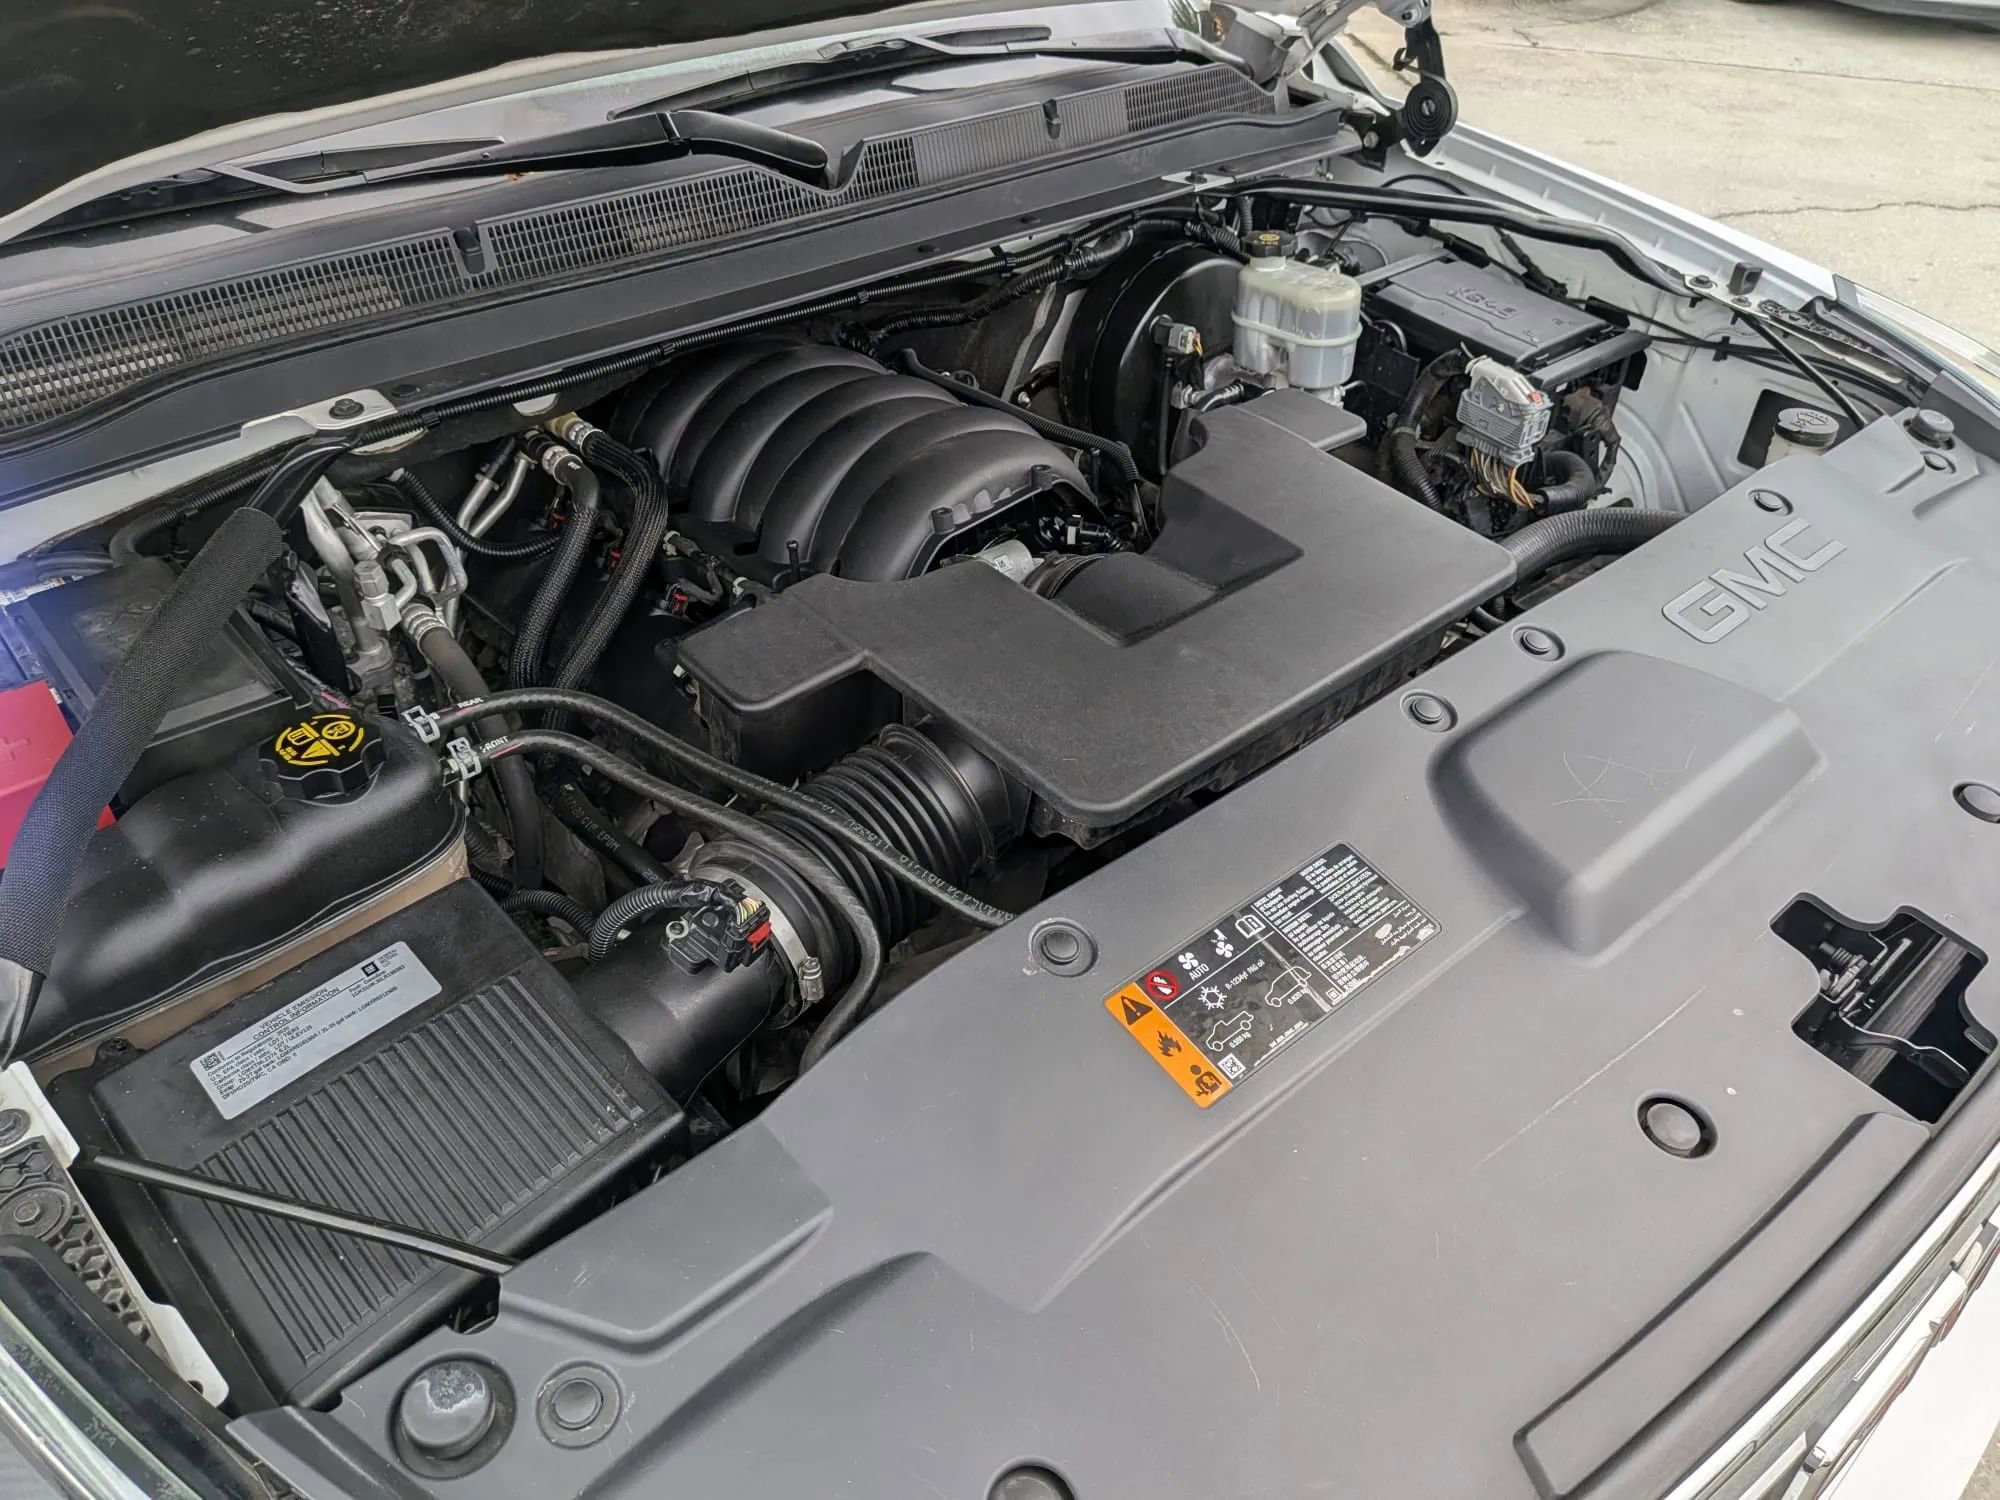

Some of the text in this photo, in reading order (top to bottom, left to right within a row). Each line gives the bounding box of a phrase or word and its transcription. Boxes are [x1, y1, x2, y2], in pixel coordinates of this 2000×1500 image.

[1661, 517, 1848, 643] GMC
[457, 697, 483, 709] REAR
[1189, 963, 1210, 981] AUTO
[1224, 971, 1249, 990] R-1234yf
[252, 987, 340, 1040] CONTROL INFORMATION
[259, 987, 328, 1029] VEHICLE EMISSION
[1241, 1031, 1252, 1039] kg
[207, 1059, 235, 1077] Conforms
[213, 1068, 241, 1086] California
